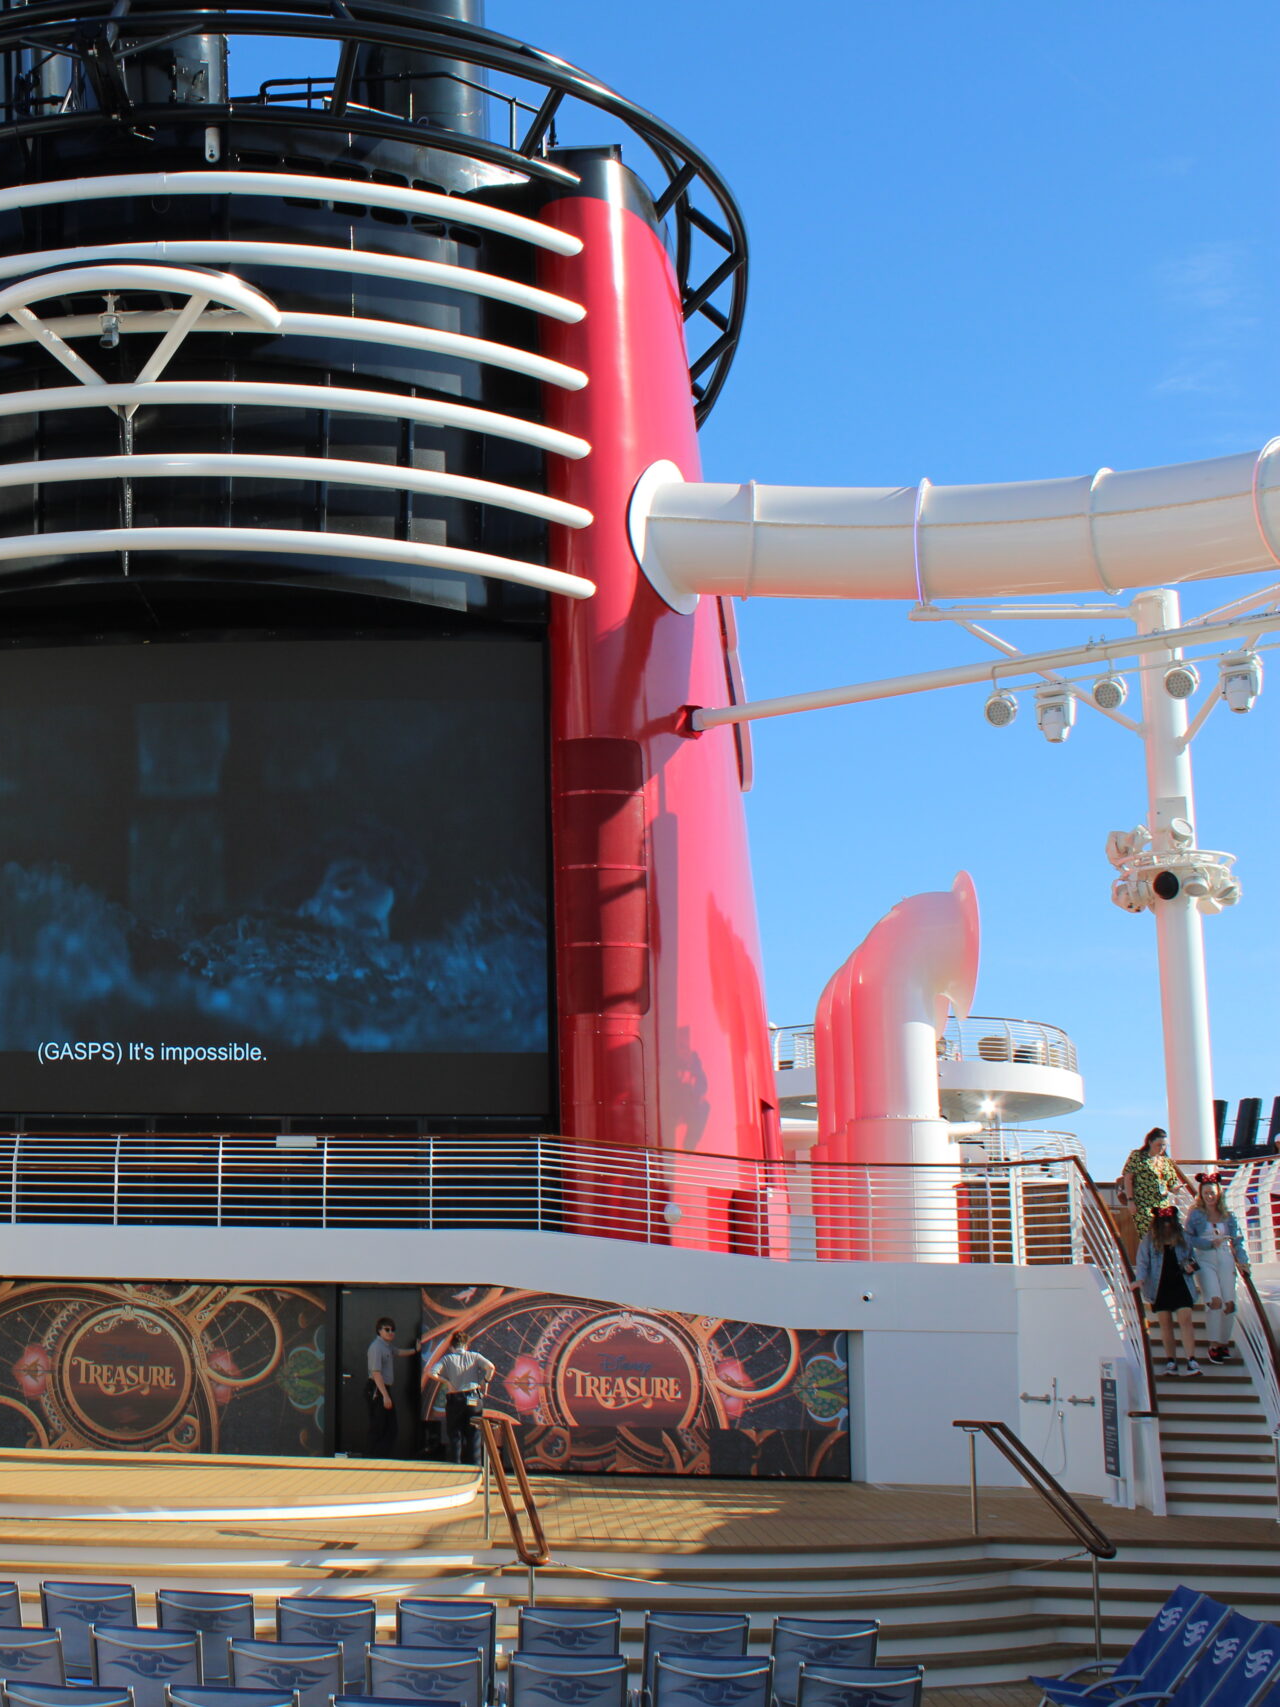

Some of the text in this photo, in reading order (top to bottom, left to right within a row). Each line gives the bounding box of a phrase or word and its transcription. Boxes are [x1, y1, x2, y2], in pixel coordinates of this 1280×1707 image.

[37, 1042, 267, 1065] (GASPS) It's impossible.
[72, 1356, 176, 1396] TREASURE
[566, 1368, 681, 1409] TREASURE
